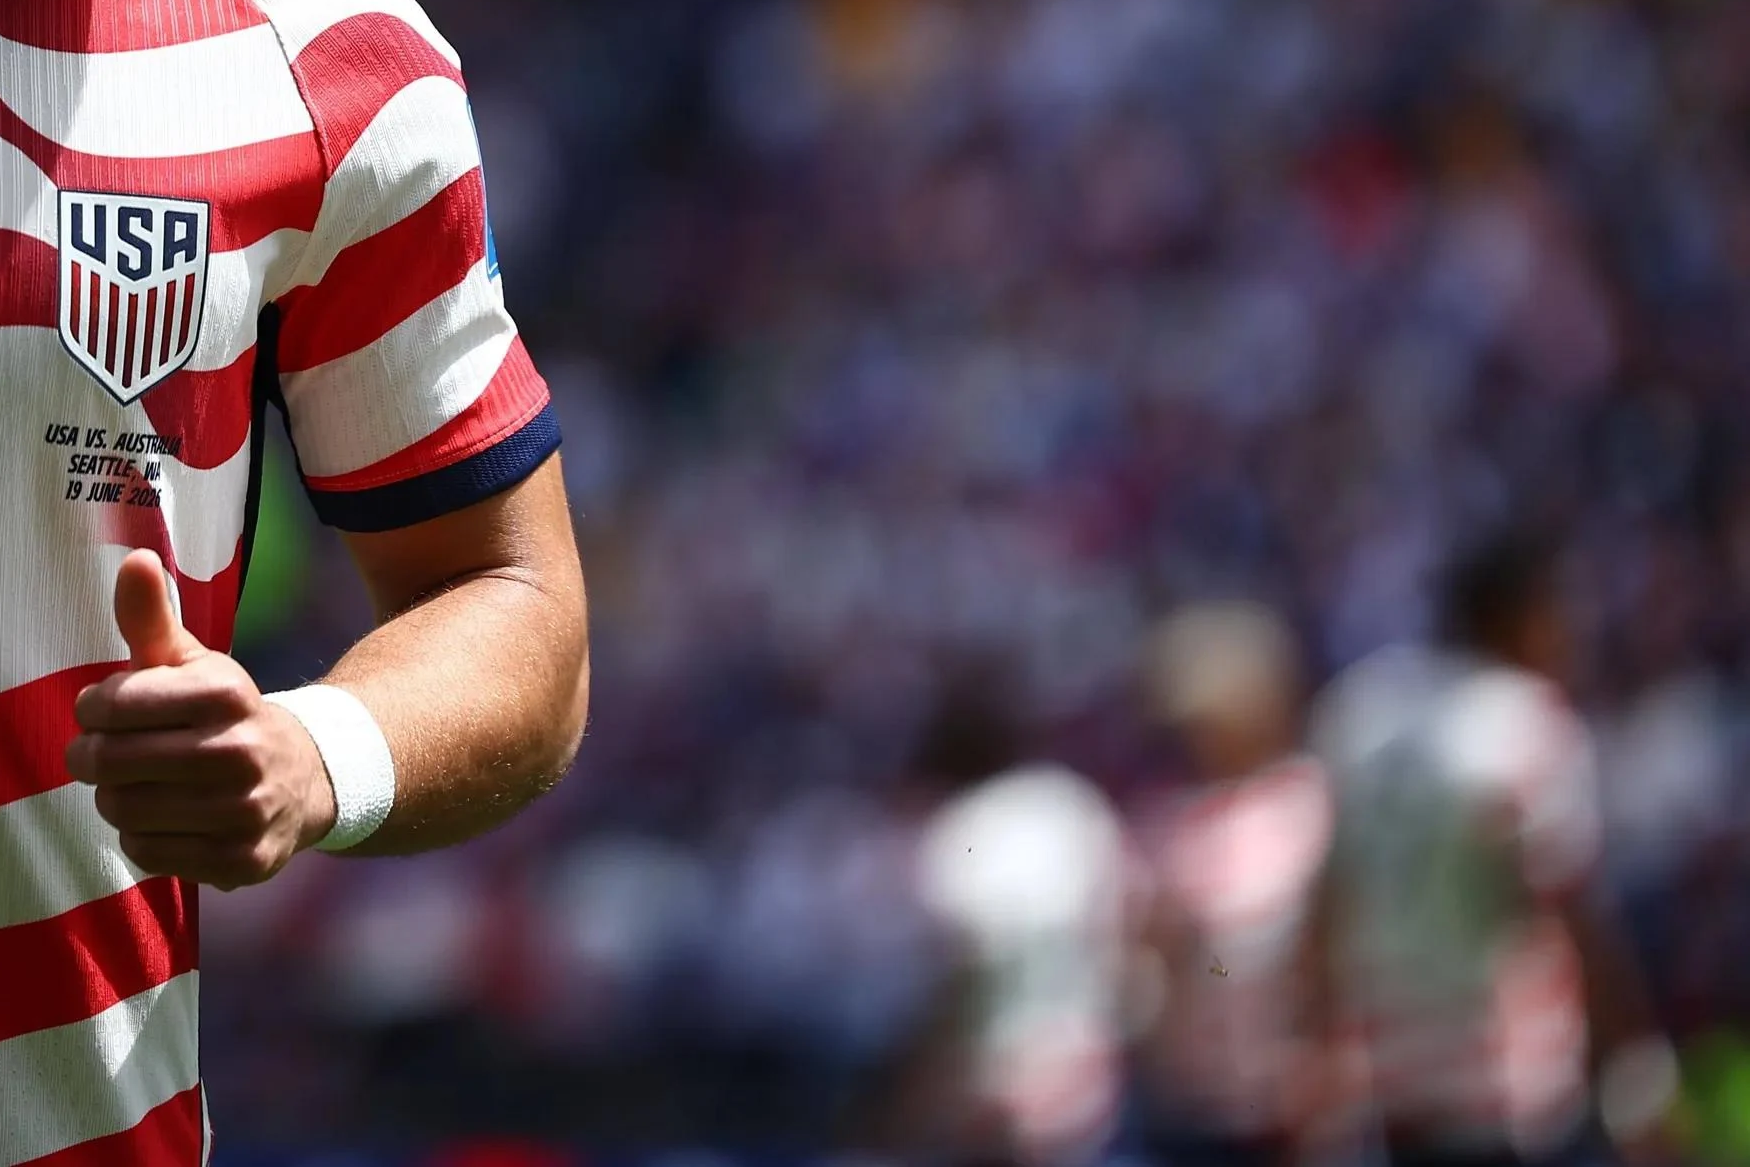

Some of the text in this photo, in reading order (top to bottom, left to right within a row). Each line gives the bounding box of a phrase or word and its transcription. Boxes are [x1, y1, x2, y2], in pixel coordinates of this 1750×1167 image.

[71, 203, 198, 281] USA
[45, 424, 182, 456] USA VS. AUSTRALIA
[68, 454, 161, 481] SEATTLE, WA
[66, 480, 162, 507] 19 JUNE 2026
